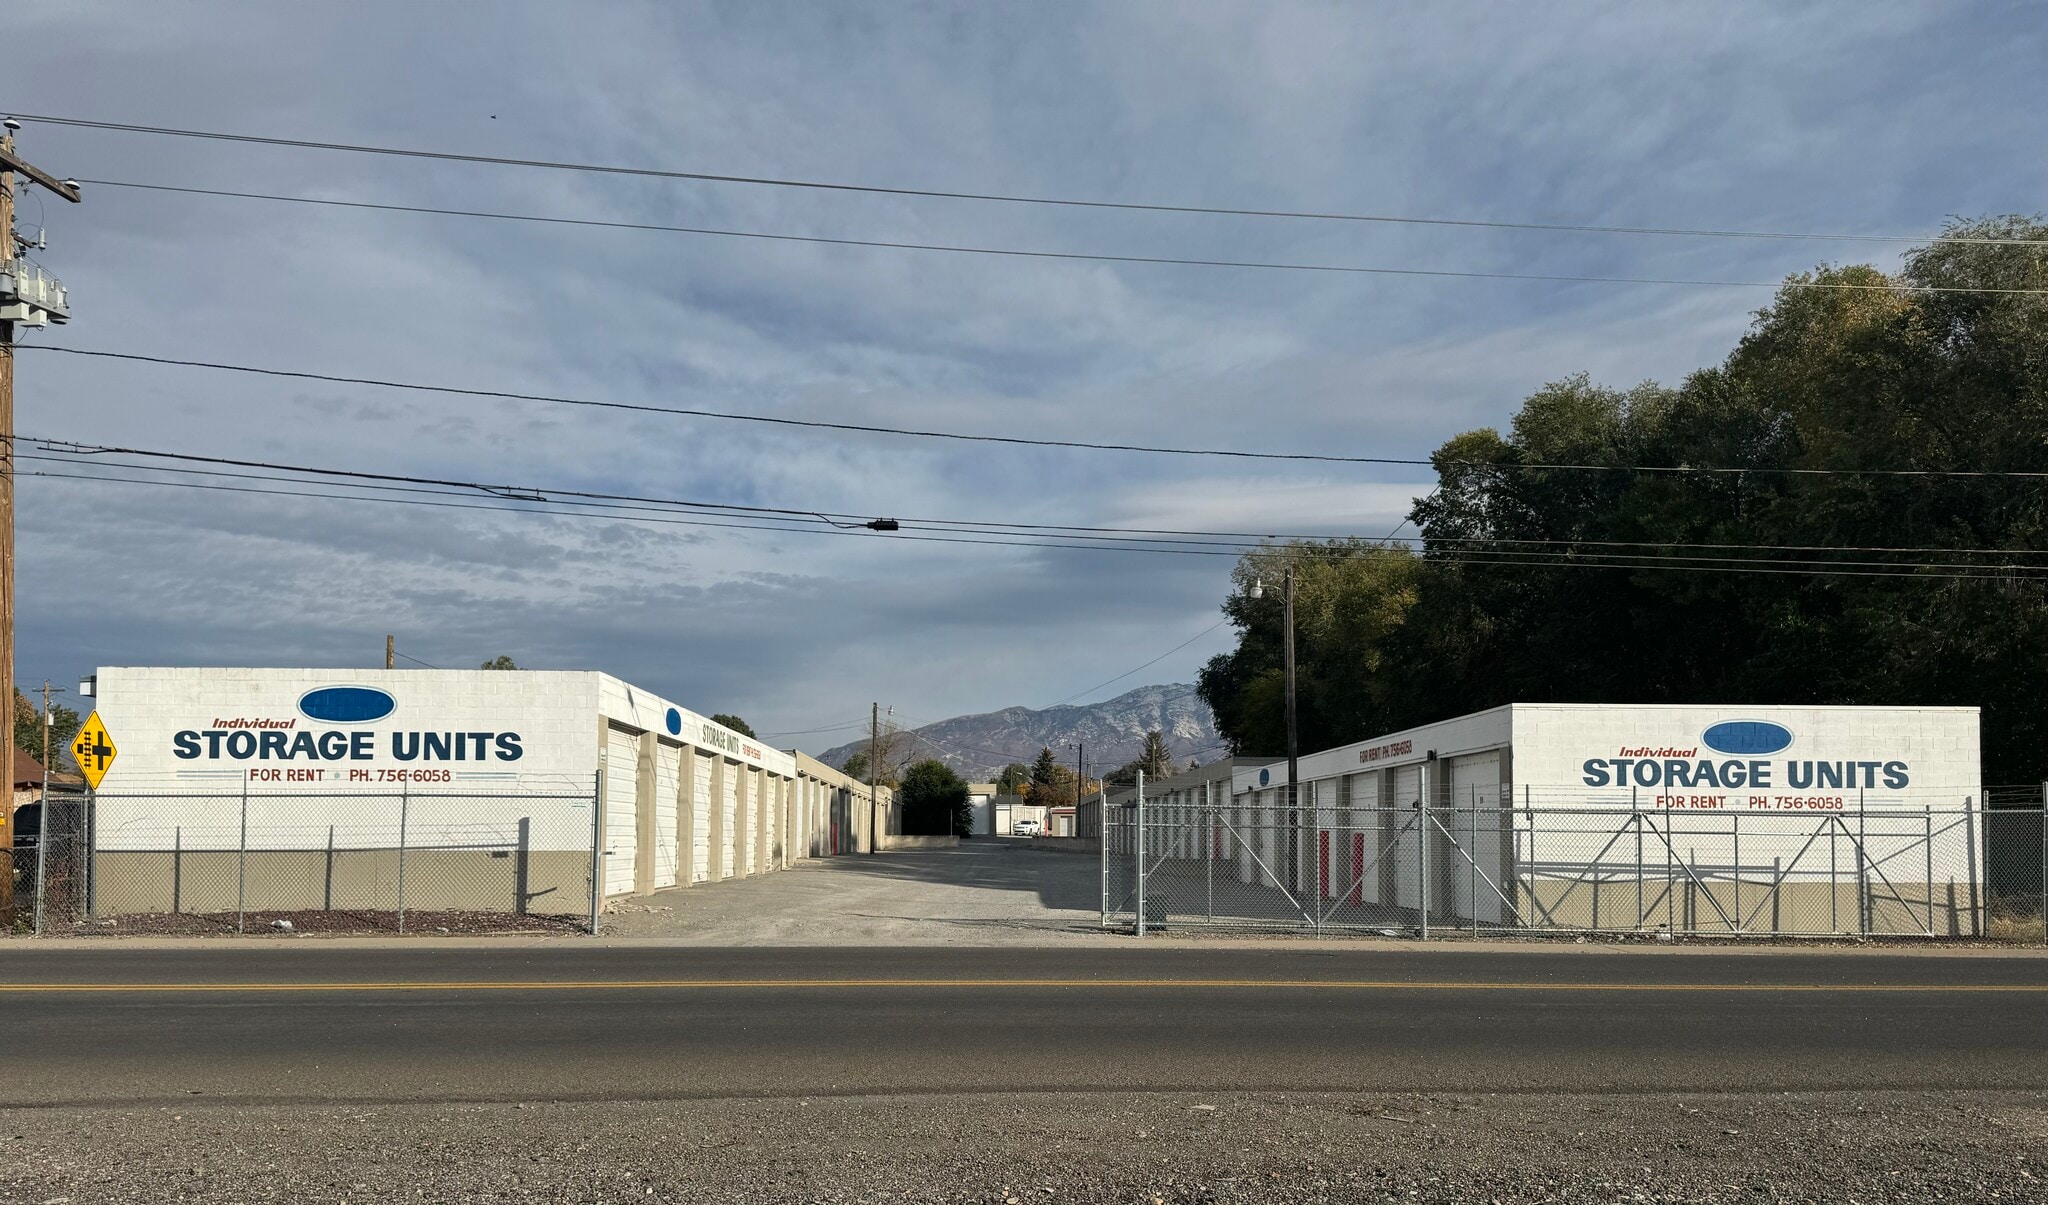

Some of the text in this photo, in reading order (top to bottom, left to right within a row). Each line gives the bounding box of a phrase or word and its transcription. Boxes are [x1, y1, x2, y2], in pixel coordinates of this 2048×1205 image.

[212, 718, 296, 729] Individual
[702, 723, 726, 750] STORAGE
[173, 730, 523, 762] STORAGE UNITS
[1619, 747, 1698, 758] Individual
[250, 769, 282, 782] FOR
[287, 769, 325, 782] RENT
[350, 769, 373, 782] PH.
[1582, 758, 1909, 789] STORAGE UNITS
[1656, 795, 1685, 809] FOR
[1690, 796, 1726, 809] RENT
[1749, 796, 1771, 809] PH.
